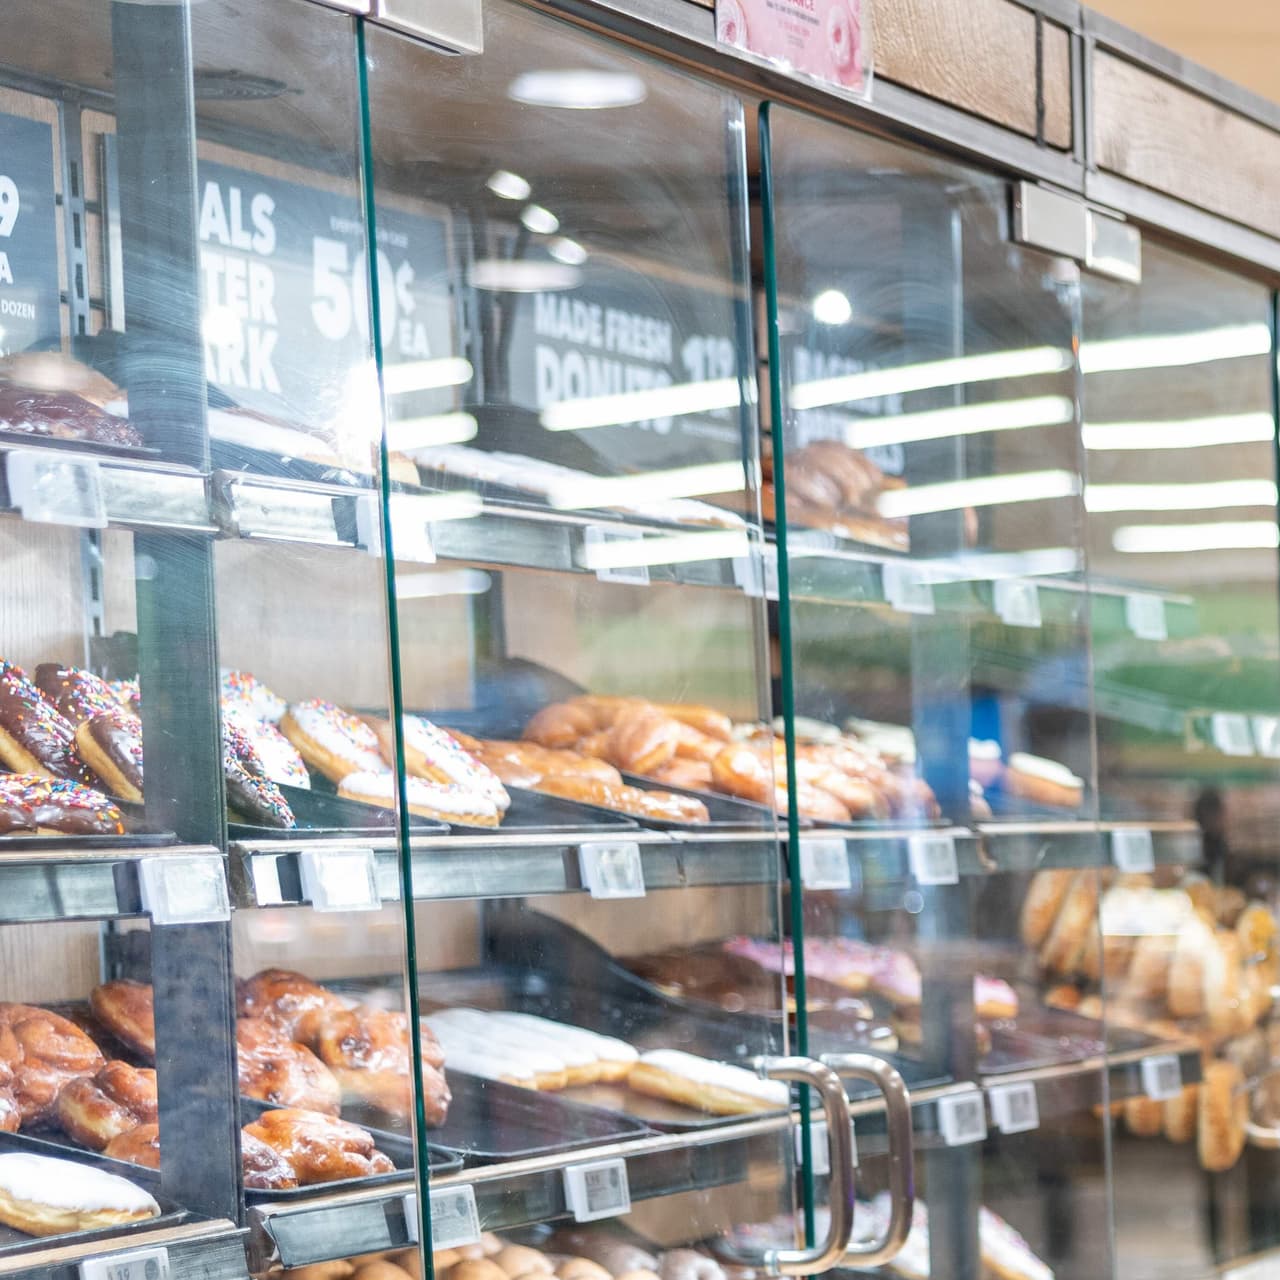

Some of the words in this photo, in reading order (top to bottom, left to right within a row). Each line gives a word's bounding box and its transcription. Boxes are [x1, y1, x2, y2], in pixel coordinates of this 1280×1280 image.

[1, 298, 36, 320] DOZEN
[535, 293, 602, 347] MADE
[605, 305, 674, 364] FRESH
[400, 318, 430, 358] EA
